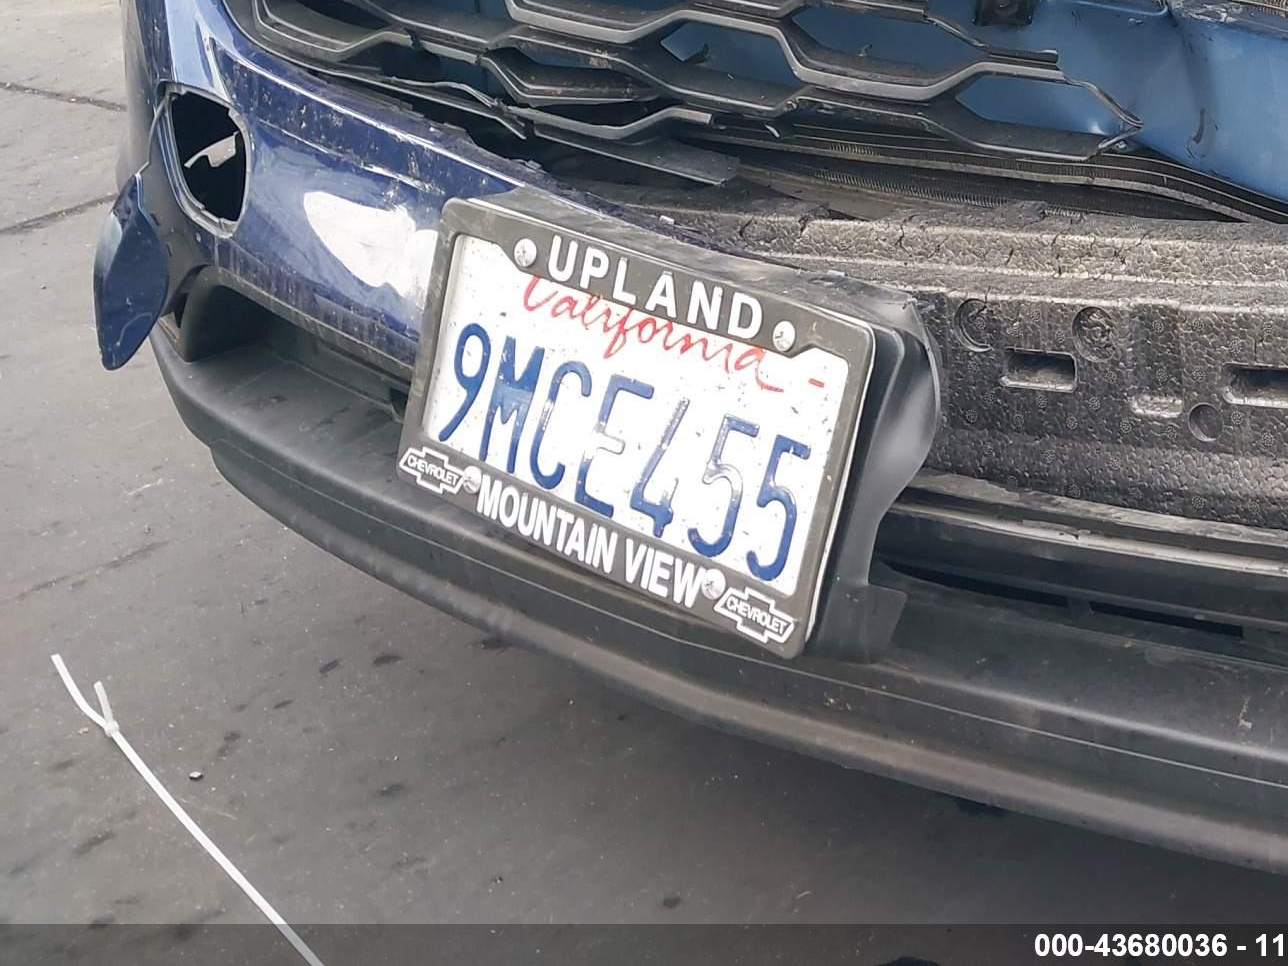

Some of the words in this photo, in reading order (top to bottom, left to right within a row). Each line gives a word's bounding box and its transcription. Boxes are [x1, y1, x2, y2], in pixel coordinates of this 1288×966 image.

[547, 235, 763, 339] UPLAND
[407, 454, 459, 486] CHEVROLET
[438, 322, 812, 582] 9MCE455
[476, 474, 618, 574] MOUNTAIN
[624, 538, 705, 609] VIEW
[726, 595, 789, 635] CHEVROLET
